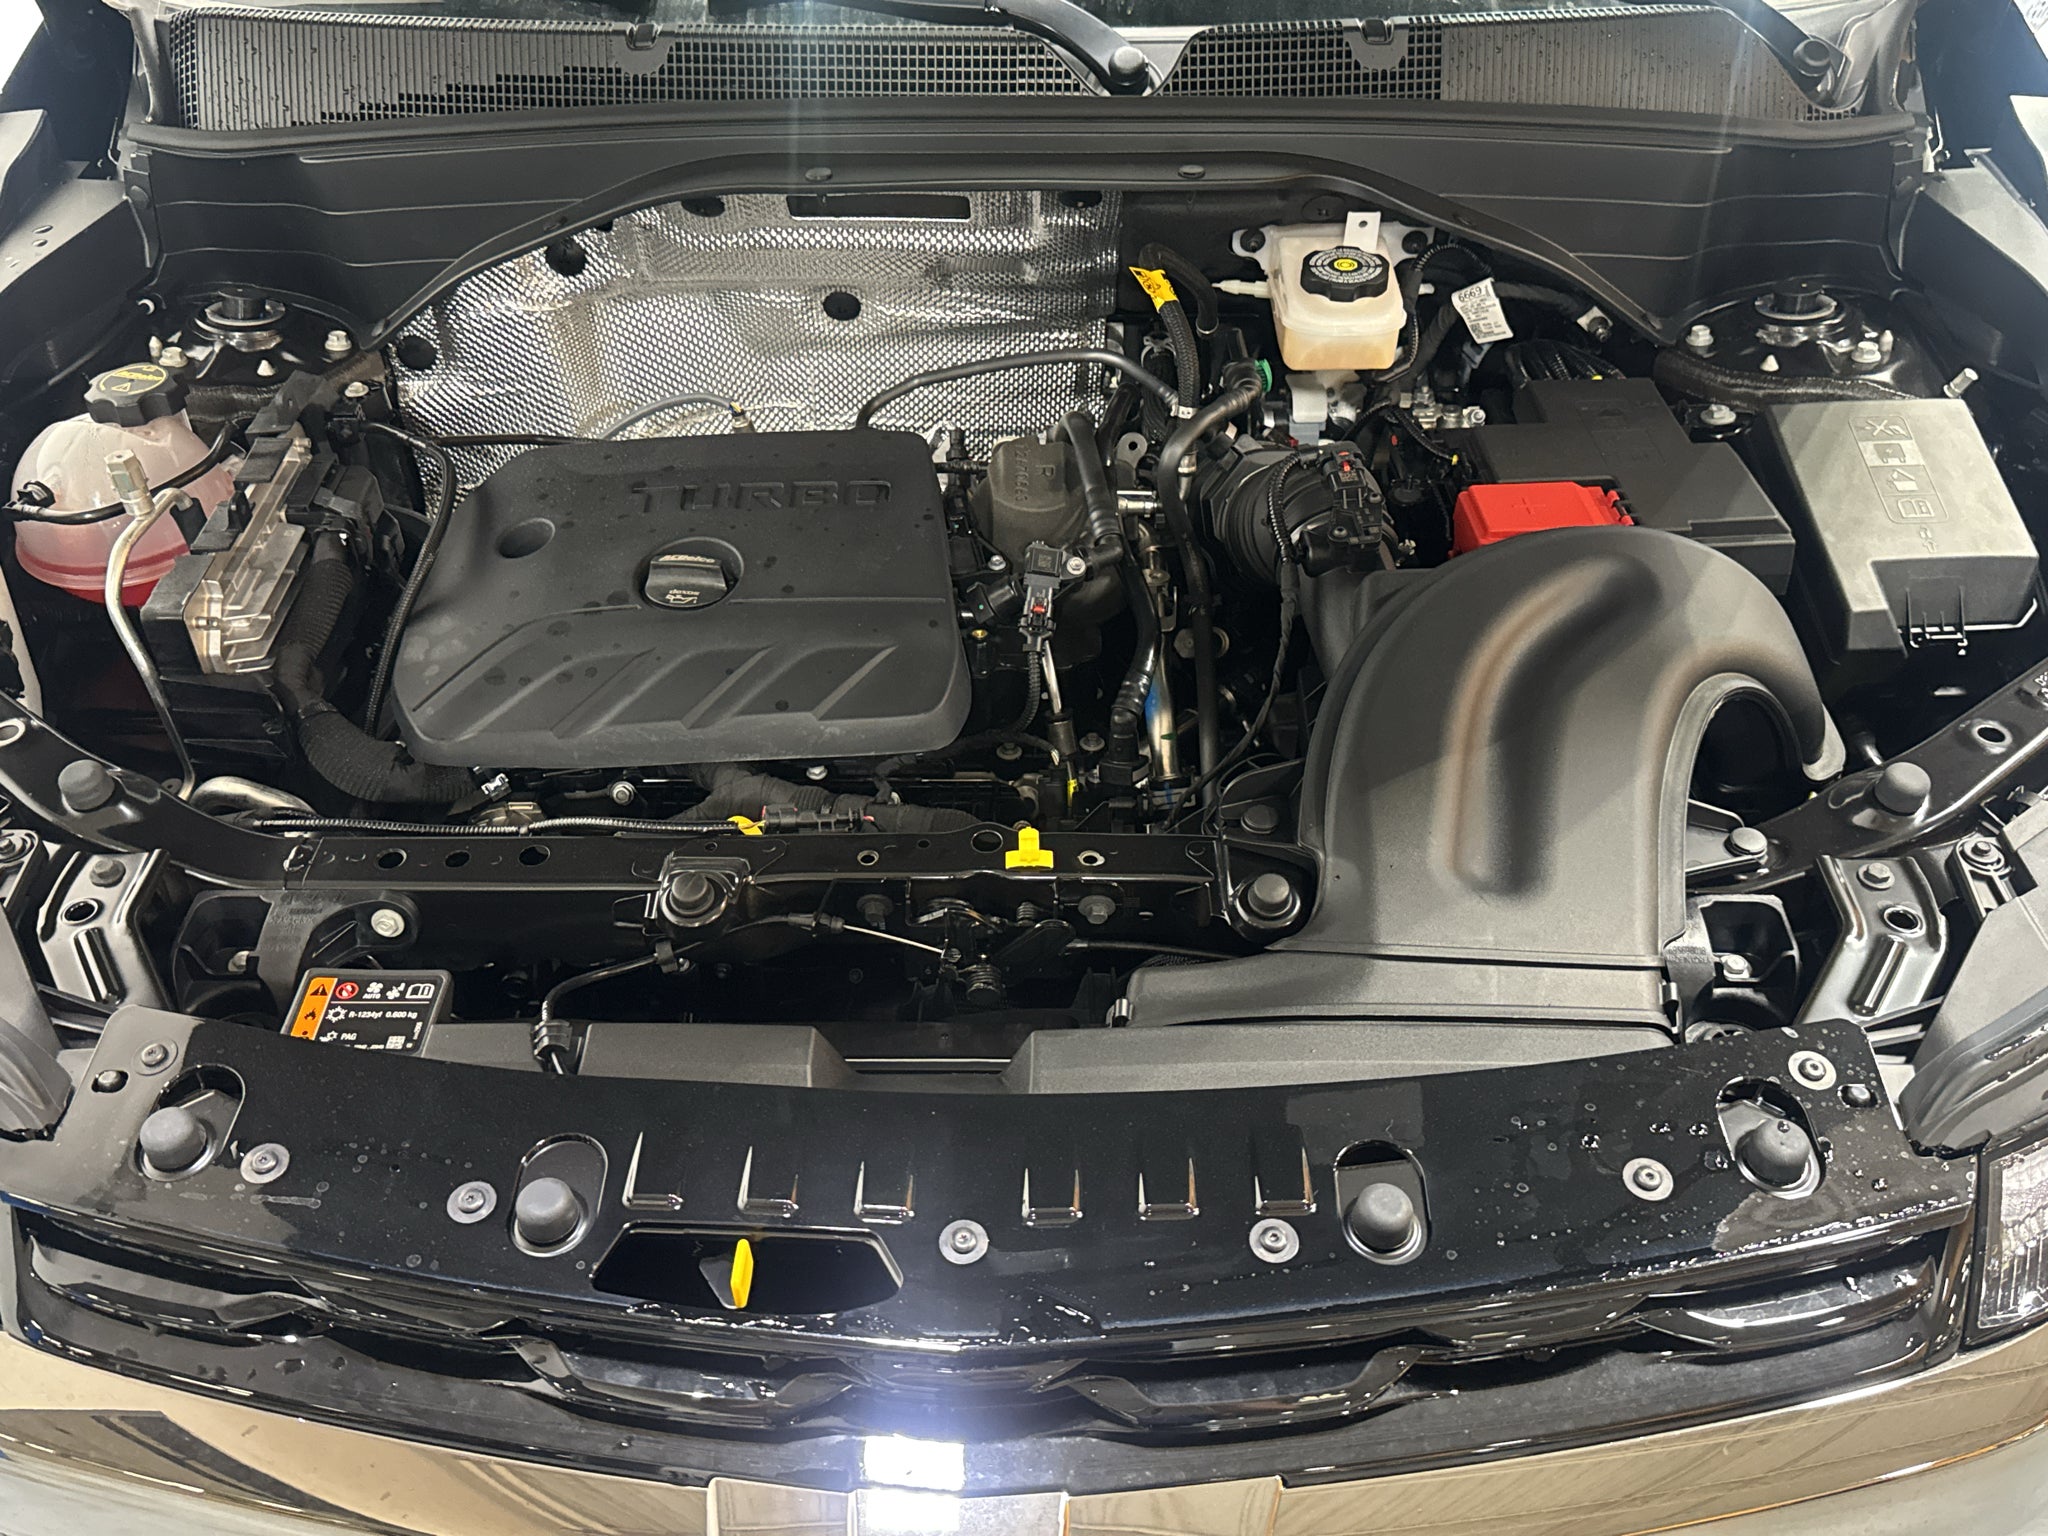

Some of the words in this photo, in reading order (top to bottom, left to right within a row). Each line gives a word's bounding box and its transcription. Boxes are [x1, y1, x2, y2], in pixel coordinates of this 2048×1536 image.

[1458, 285, 1482, 303] 6669
[632, 480, 892, 513] TURBO
[658, 554, 715, 563] ACDelco
[348, 1011, 383, 1019] R-1234yf
[407, 1011, 418, 1019] kg
[340, 1032, 358, 1041] PAG
